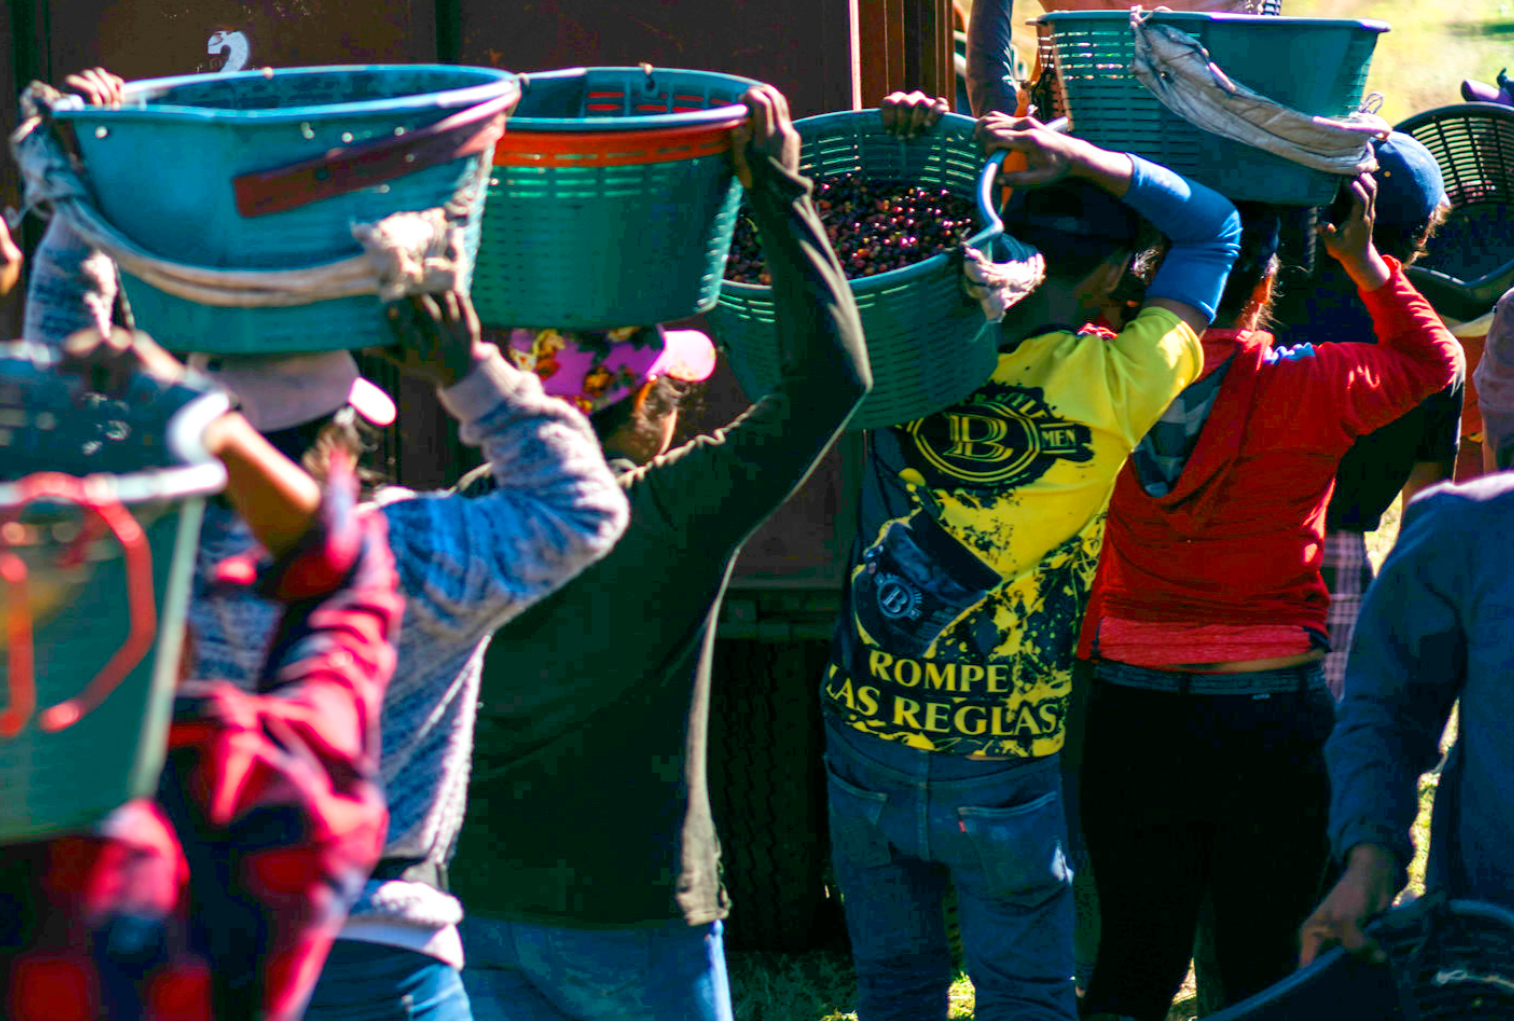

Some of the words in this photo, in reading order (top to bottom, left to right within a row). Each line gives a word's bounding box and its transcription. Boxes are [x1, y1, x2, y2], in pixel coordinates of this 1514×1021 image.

[207, 30, 250, 73] 2
[943, 413, 1014, 462] B
[1041, 429, 1077, 447] MEN
[869, 650, 1010, 693] ROMPE
[892, 696, 1059, 736] REGLAS
